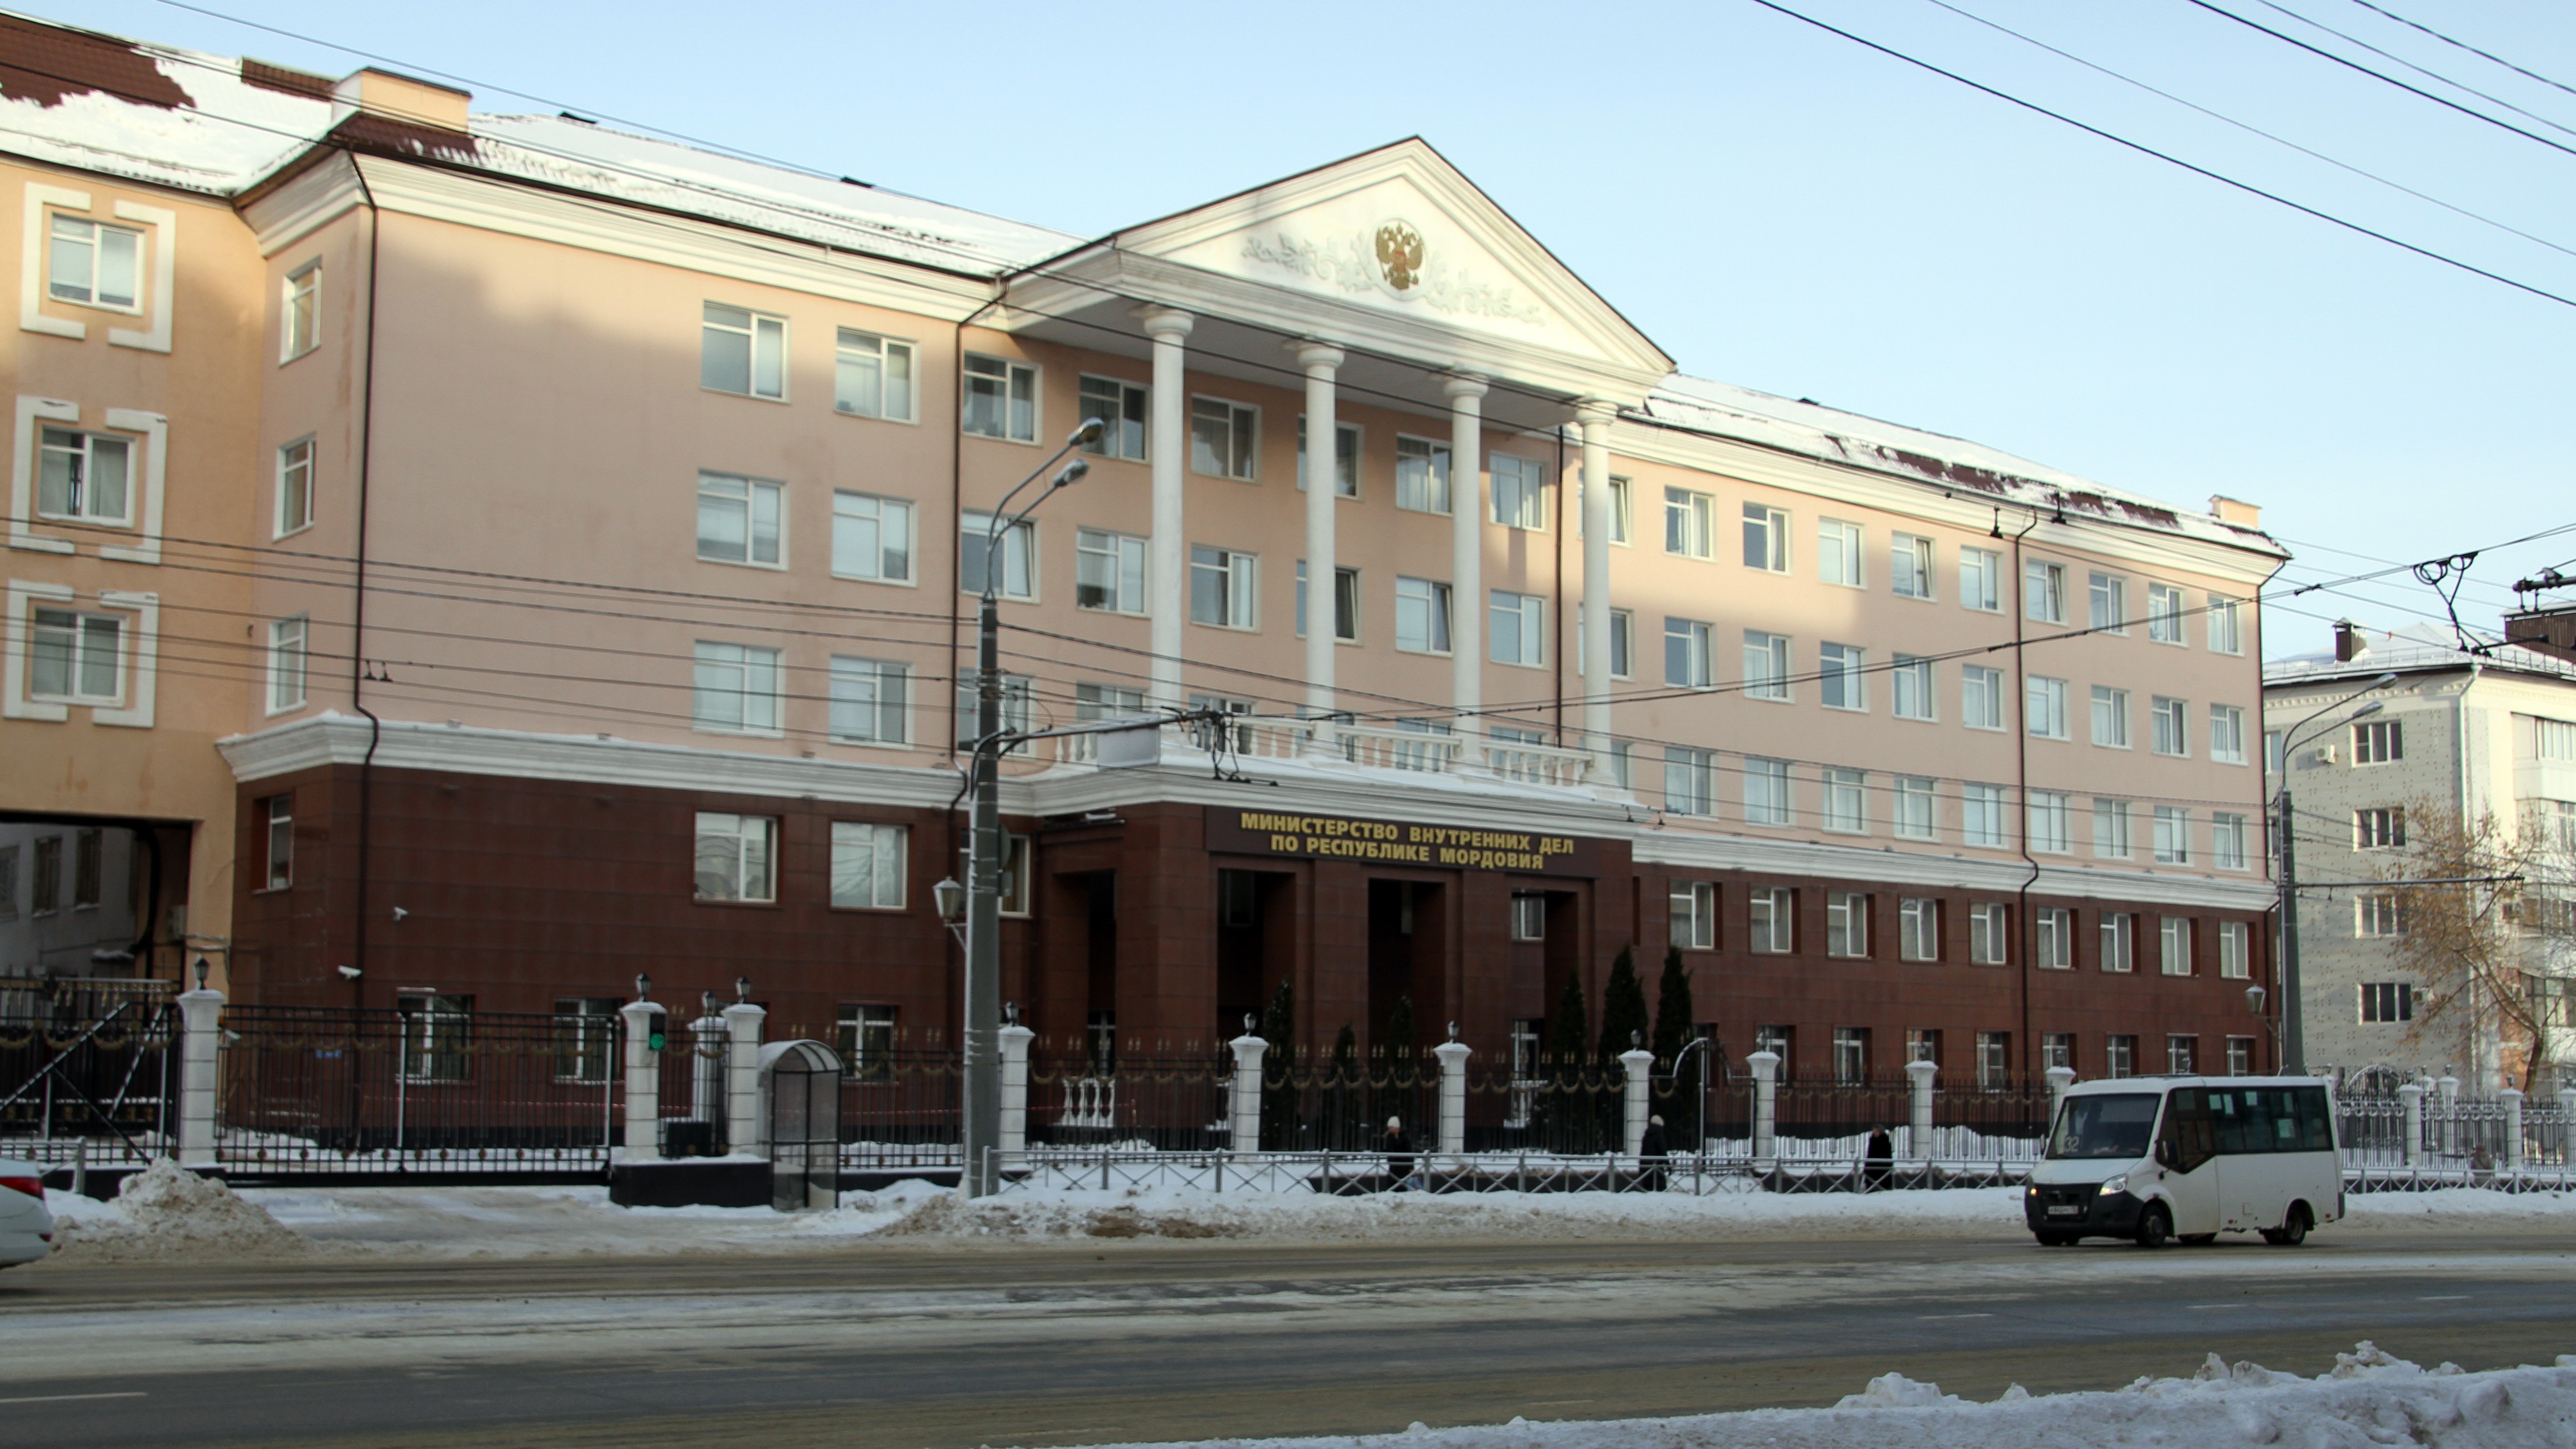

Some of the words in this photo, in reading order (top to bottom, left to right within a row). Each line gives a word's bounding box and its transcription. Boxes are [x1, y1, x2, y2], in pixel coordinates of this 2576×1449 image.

[1240, 812, 1399, 840] МИНИСТЕРСТВО
[1410, 826, 1531, 851] ВНУТРЕННИХ
[1539, 836, 1574, 855] ДЕЛ
[1271, 834, 1299, 852] ПО
[1306, 837, 1430, 862] РЕСПУБЛИКЕ
[1439, 847, 1544, 870] МОРДОВИЯ
[2064, 1136, 2080, 1152] 32
